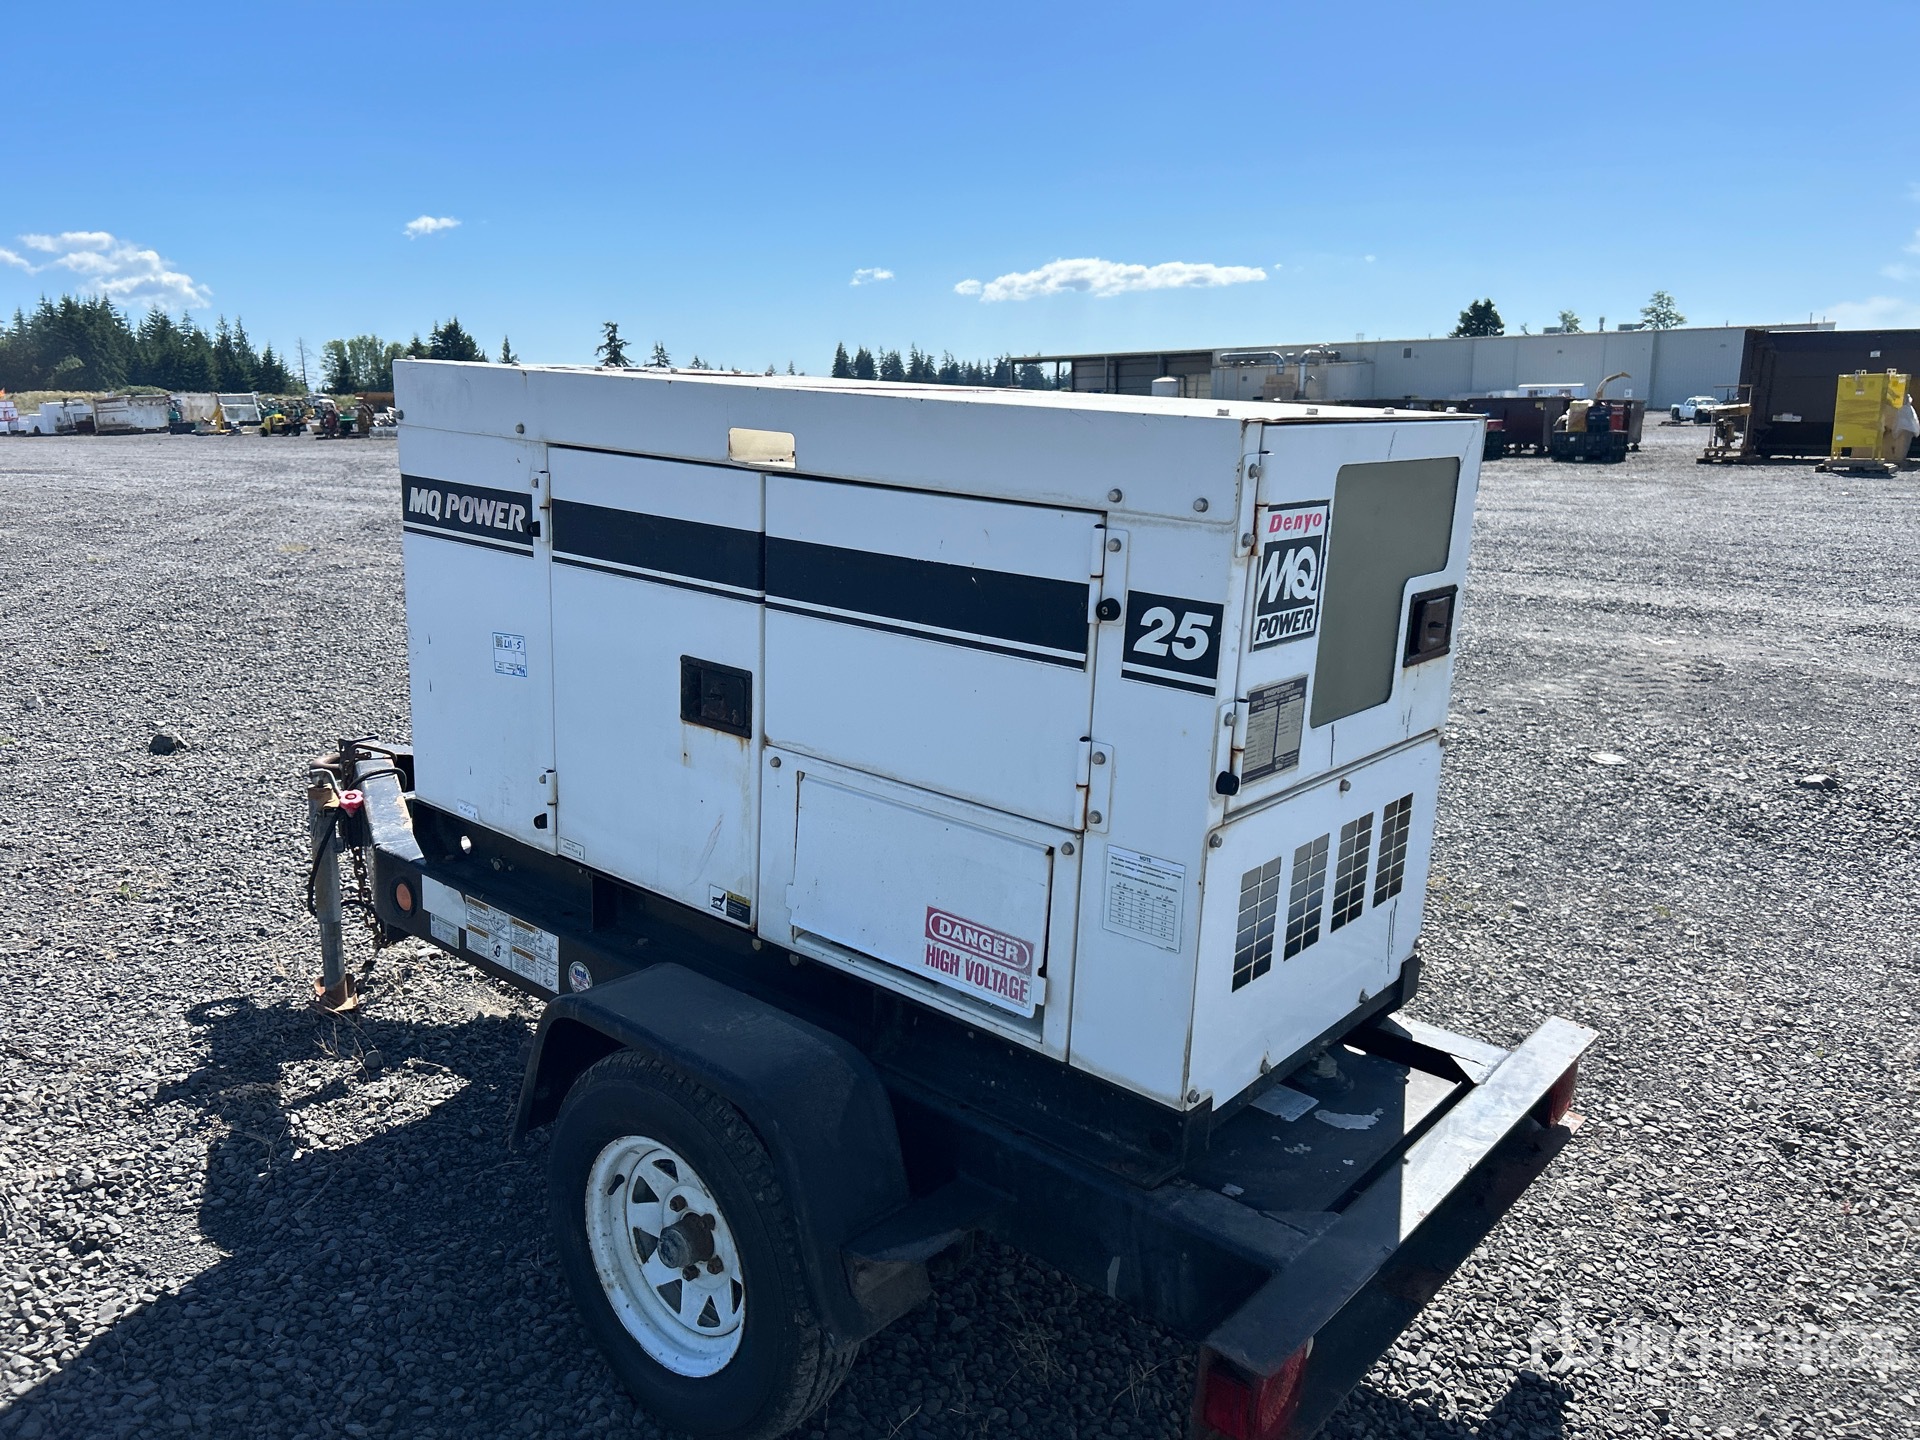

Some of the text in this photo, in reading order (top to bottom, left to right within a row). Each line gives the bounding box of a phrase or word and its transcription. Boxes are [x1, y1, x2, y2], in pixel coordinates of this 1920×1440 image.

[409, 487, 526, 533] MQ POWER
[1268, 513, 1323, 533] Denyo
[1258, 546, 1317, 604] MQ
[1133, 606, 1214, 661] 25
[1255, 608, 1313, 641] POWER
[1139, 855, 1152, 863] NOTE
[939, 919, 1019, 962] DANGER
[925, 944, 1028, 1002] HIGH VOLTAGE
